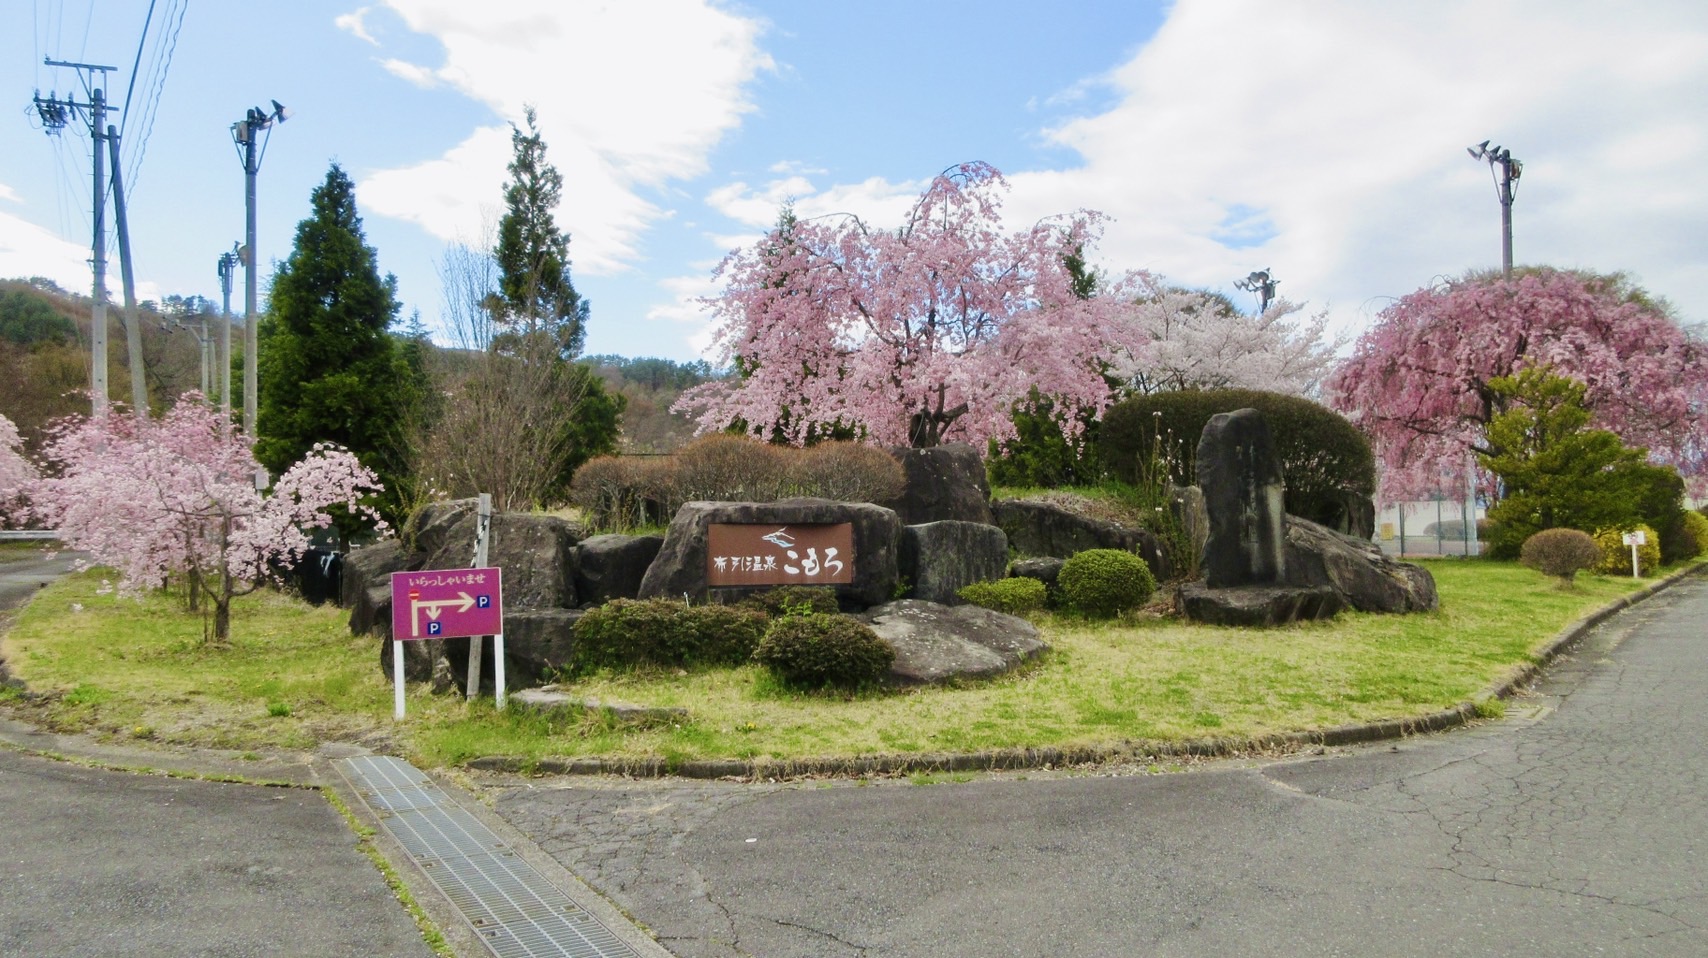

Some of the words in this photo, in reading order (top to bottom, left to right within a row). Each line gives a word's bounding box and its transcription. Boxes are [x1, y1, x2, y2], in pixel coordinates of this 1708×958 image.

[713, 554, 778, 573] 布引温泉
[783, 547, 844, 577] こもろ
[409, 574, 486, 587] いらっしゃいませ
[479, 596, 488, 608] P
[429, 623, 439, 634] P
